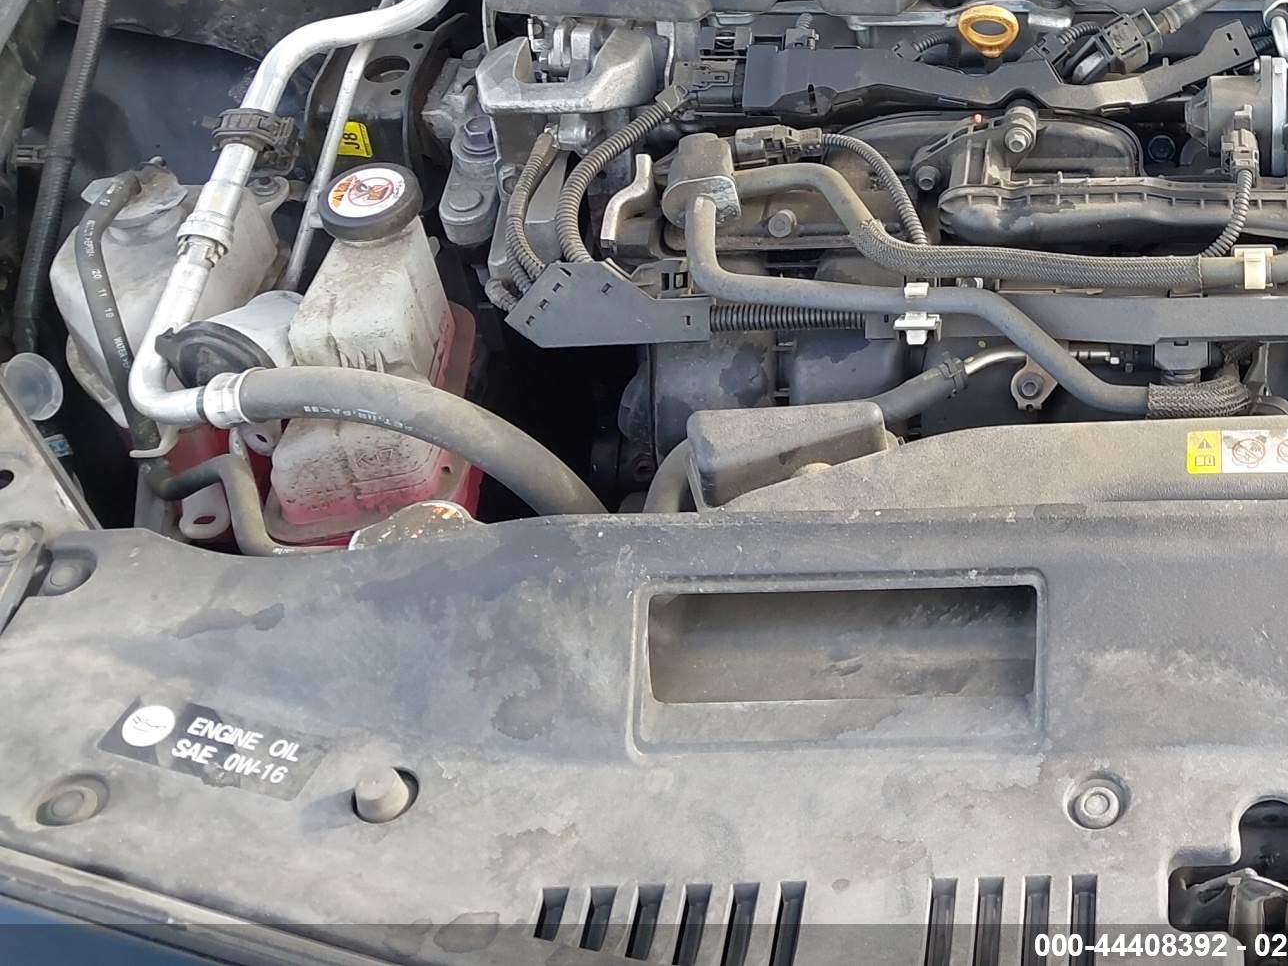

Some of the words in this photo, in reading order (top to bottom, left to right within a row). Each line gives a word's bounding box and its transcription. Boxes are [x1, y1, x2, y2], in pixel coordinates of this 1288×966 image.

[342, 131, 361, 150] J8
[171, 738, 218, 765] SAE
[223, 753, 289, 784] 0W-16
[187, 716, 264, 751] ENGINE
[268, 739, 300, 763] OIL
